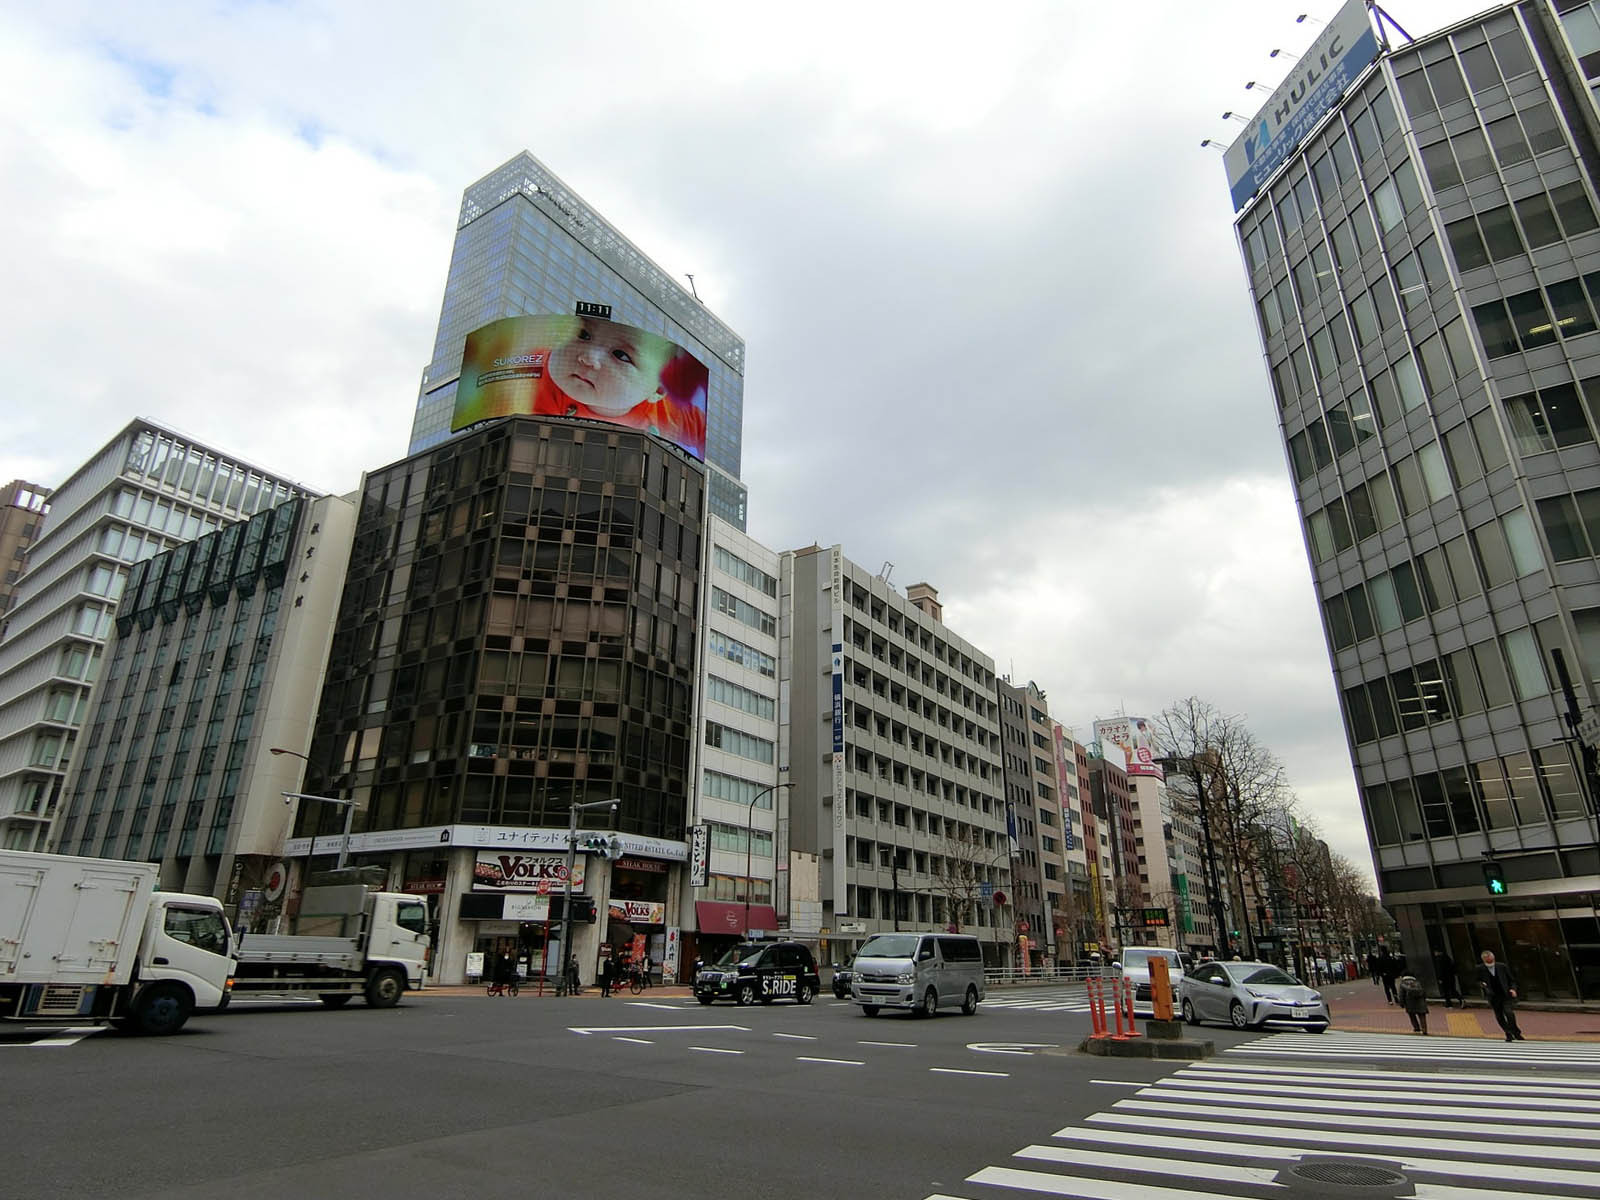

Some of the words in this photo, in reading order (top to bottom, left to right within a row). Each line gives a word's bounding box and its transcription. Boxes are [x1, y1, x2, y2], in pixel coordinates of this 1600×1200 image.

[1274, 34, 1345, 126] HULIC
[1253, 73, 1350, 185] ヒューリック株式会社
[579, 302, 610, 316] 11:11
[494, 354, 544, 367] SUKOREZ
[693, 827, 703, 876] やきとり
[498, 855, 564, 880] VOLKS
[624, 902, 650, 918] VOLKS
